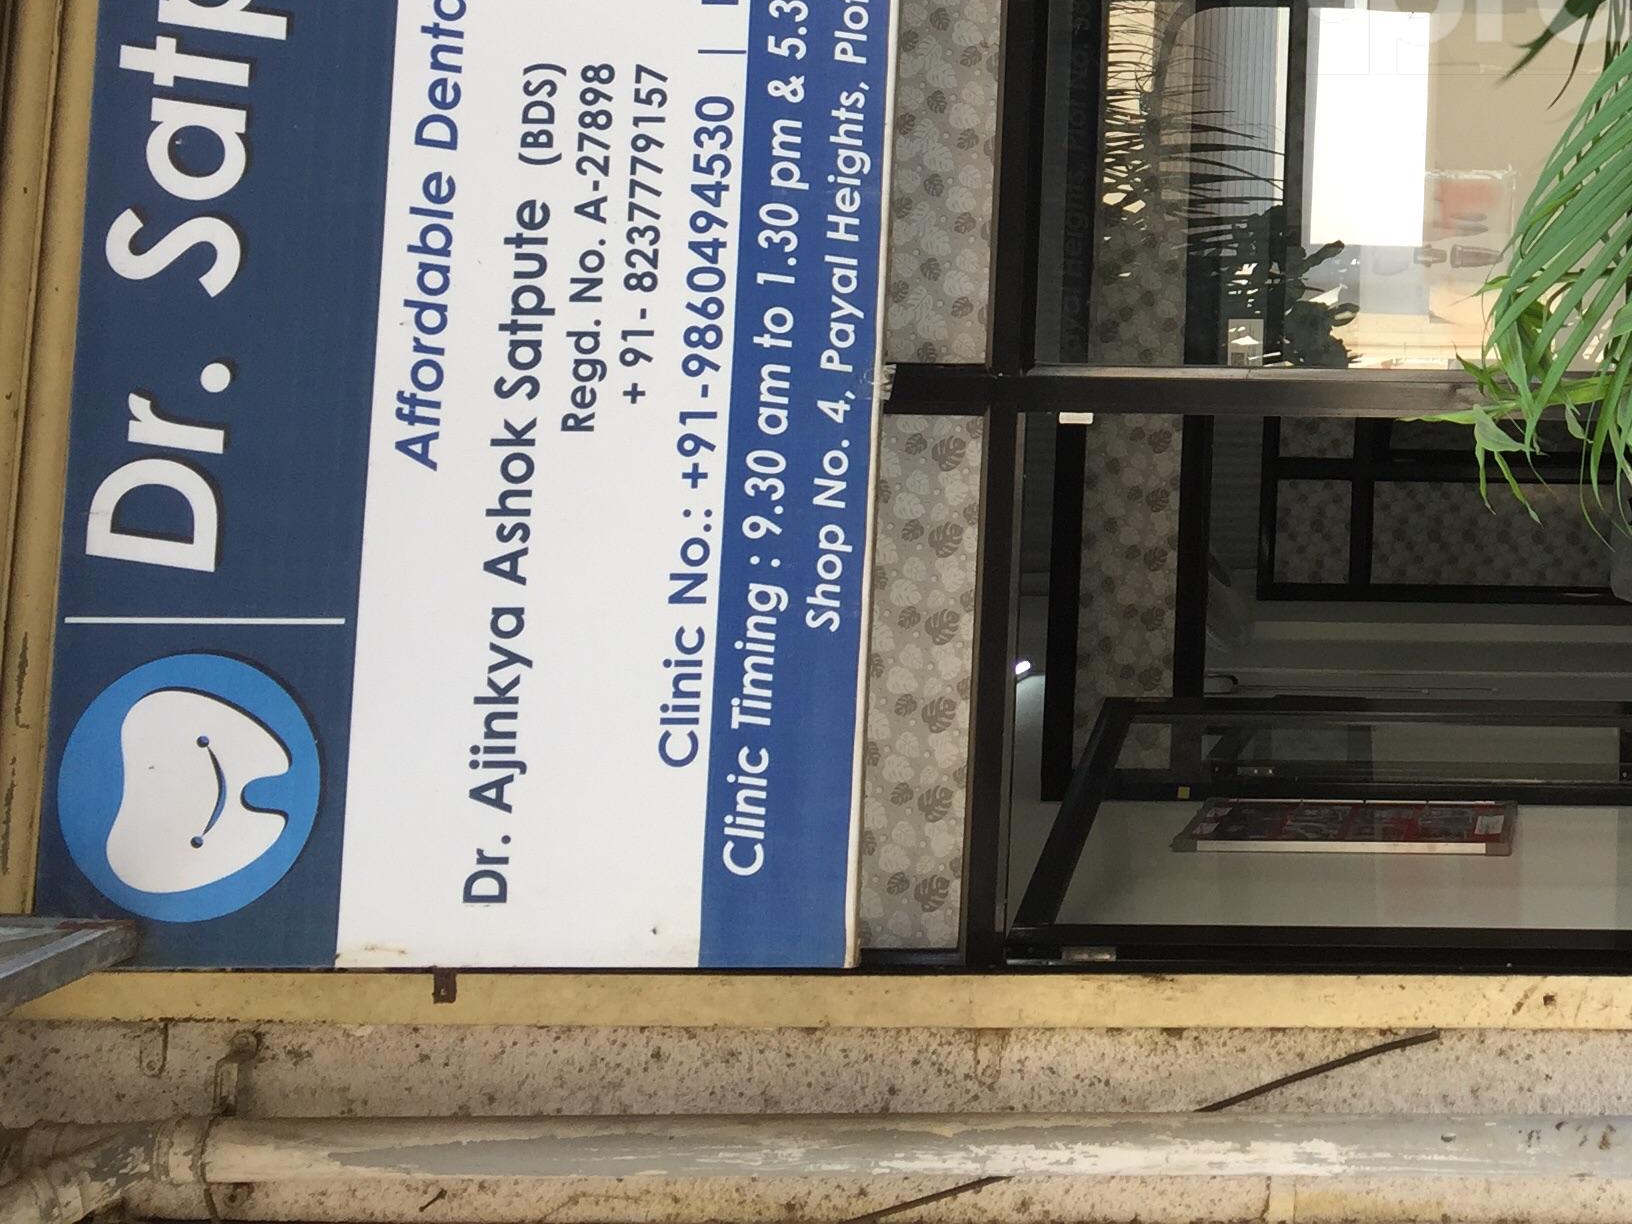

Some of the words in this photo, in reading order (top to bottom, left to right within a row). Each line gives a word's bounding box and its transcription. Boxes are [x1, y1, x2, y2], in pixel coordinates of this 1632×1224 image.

[519, 64, 566, 165] (BDS)
[574, 64, 615, 224] A-27898
[768, 76, 804, 103] &
[624, 64, 668, 292] 8237779157
[771, 120, 809, 189] pm
[827, 82, 875, 241] Heights,
[569, 239, 606, 302] No.
[677, 96, 734, 488] +91-9860494530
[757, 203, 798, 284] 1.30
[395, 172, 455, 471] Affordable
[494, 200, 555, 400] Satpute
[754, 307, 793, 347] to
[821, 255, 864, 372] Payal
[561, 320, 607, 431] Regd.
[758, 364, 790, 434] am
[817, 391, 855, 423] 4,
[86, 363, 230, 572] Dr.
[483, 418, 537, 585] Ashok
[742, 450, 786, 538] 9.30
[813, 440, 849, 508] No.
[668, 509, 712, 604] No.:
[806, 525, 852, 632] Shop
[469, 607, 532, 813] Ajinkya
[659, 627, 705, 767] Clinic
[731, 583, 788, 729] Timing
[723, 747, 768, 875] Clinic
[463, 835, 511, 903] Dr.
